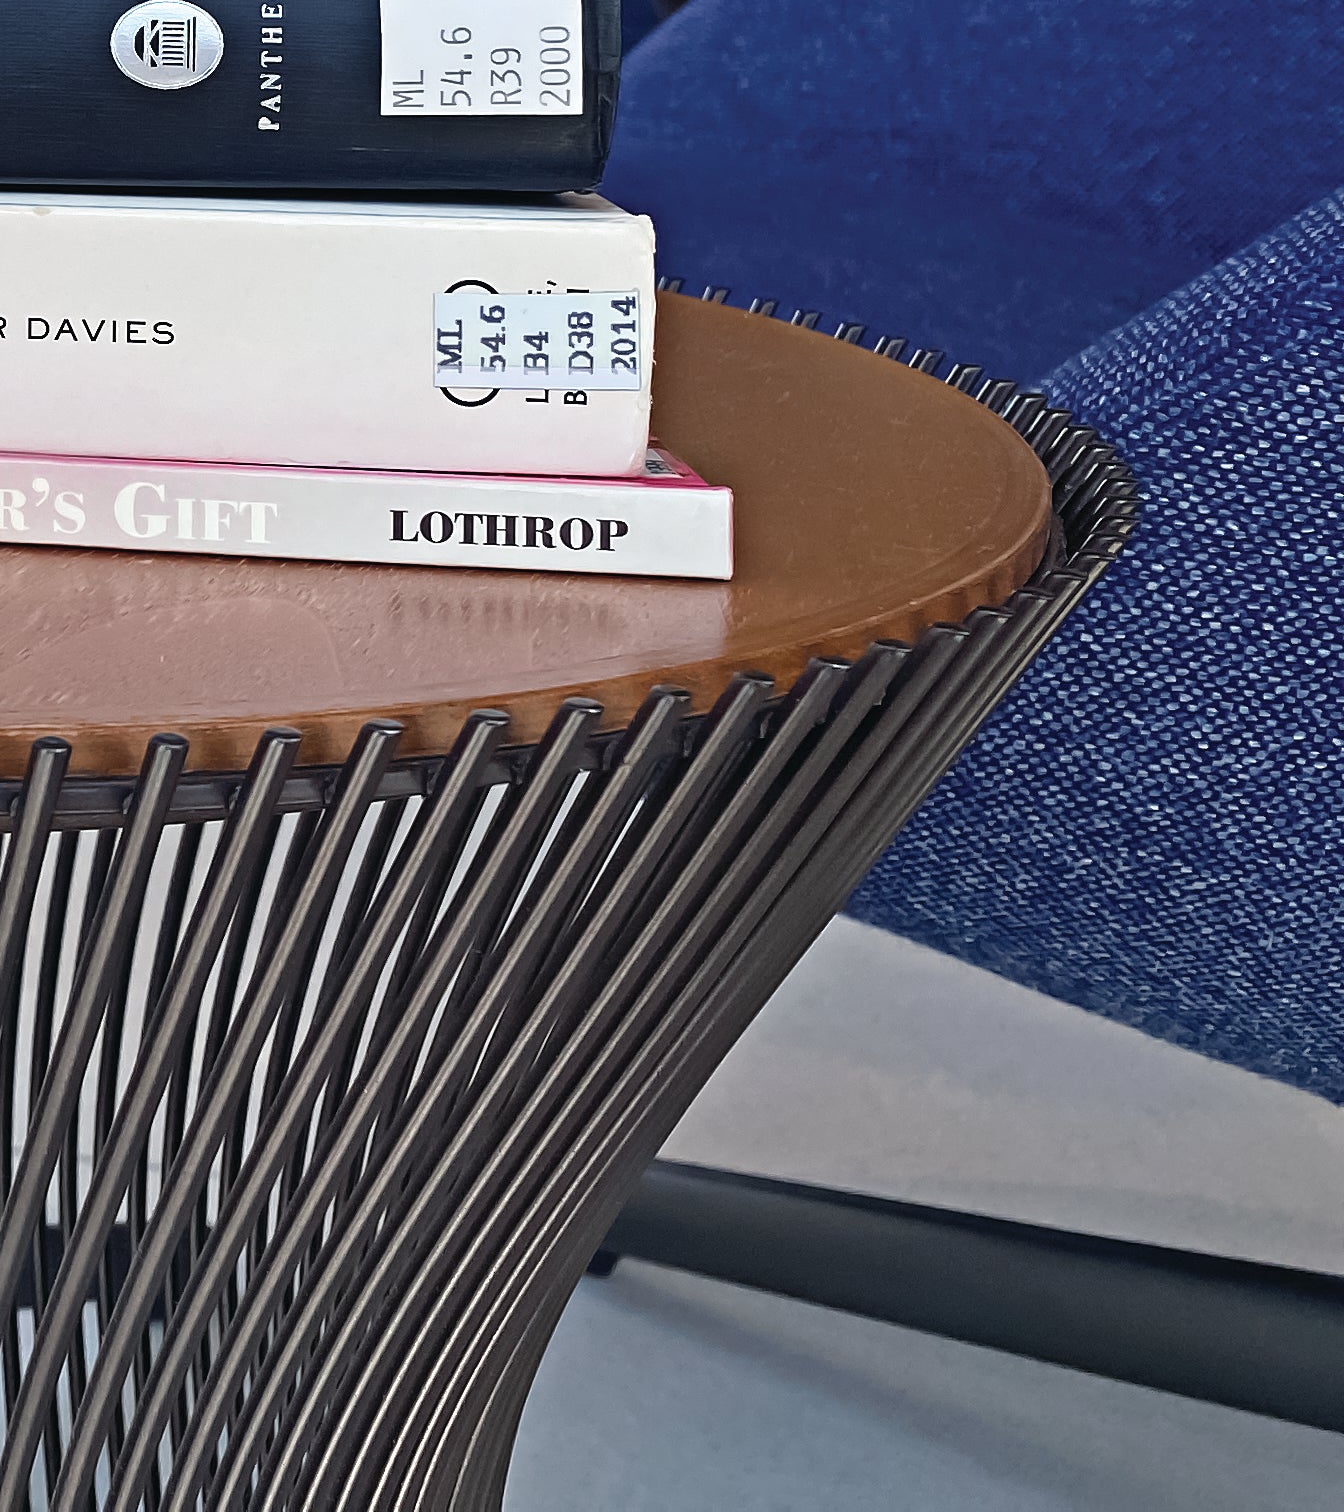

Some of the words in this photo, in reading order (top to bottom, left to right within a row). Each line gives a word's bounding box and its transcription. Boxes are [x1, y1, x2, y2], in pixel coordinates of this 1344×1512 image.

[392, 69, 425, 108] ML
[439, 27, 473, 107] 54.6
[490, 47, 522, 105] R39
[539, 26, 571, 107] 2000
[27, 317, 175, 345] DAVIES
[436, 319, 463, 374] ML
[479, 304, 507, 373] 54.6
[523, 330, 550, 376] B4
[567, 311, 594, 375] D38
[610, 295, 637, 375] 2014
[111, 480, 280, 546] GIFT
[388, 509, 629, 552] LOTHROP
